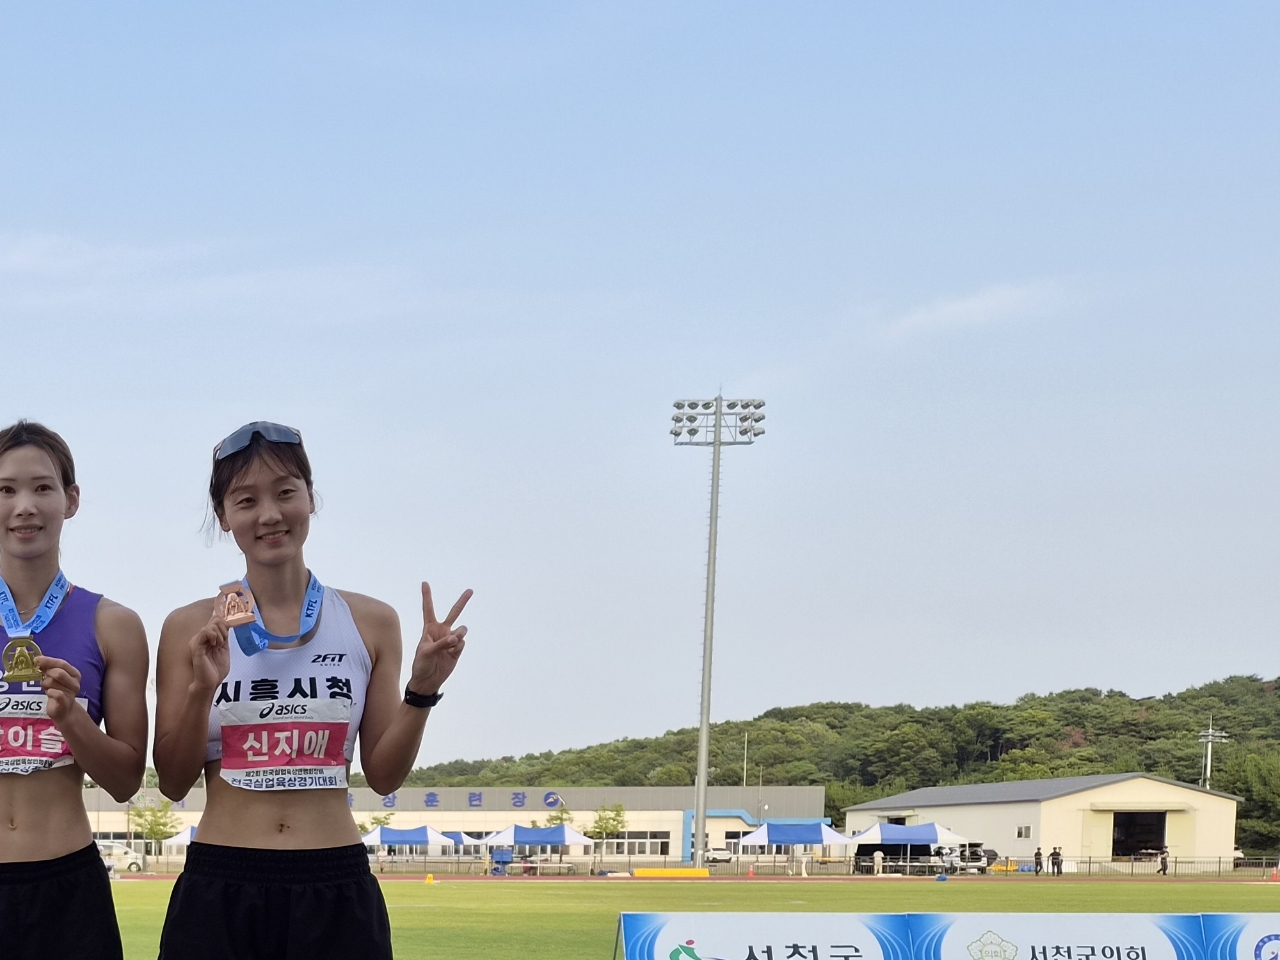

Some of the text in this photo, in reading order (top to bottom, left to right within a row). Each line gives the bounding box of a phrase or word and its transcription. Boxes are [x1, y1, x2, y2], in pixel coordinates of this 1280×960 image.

[44, 593, 59, 610] KTFL
[305, 599, 318, 618] KTFL
[214, 676, 353, 706] 시흥시청
[242, 729, 330, 761] 신지애
